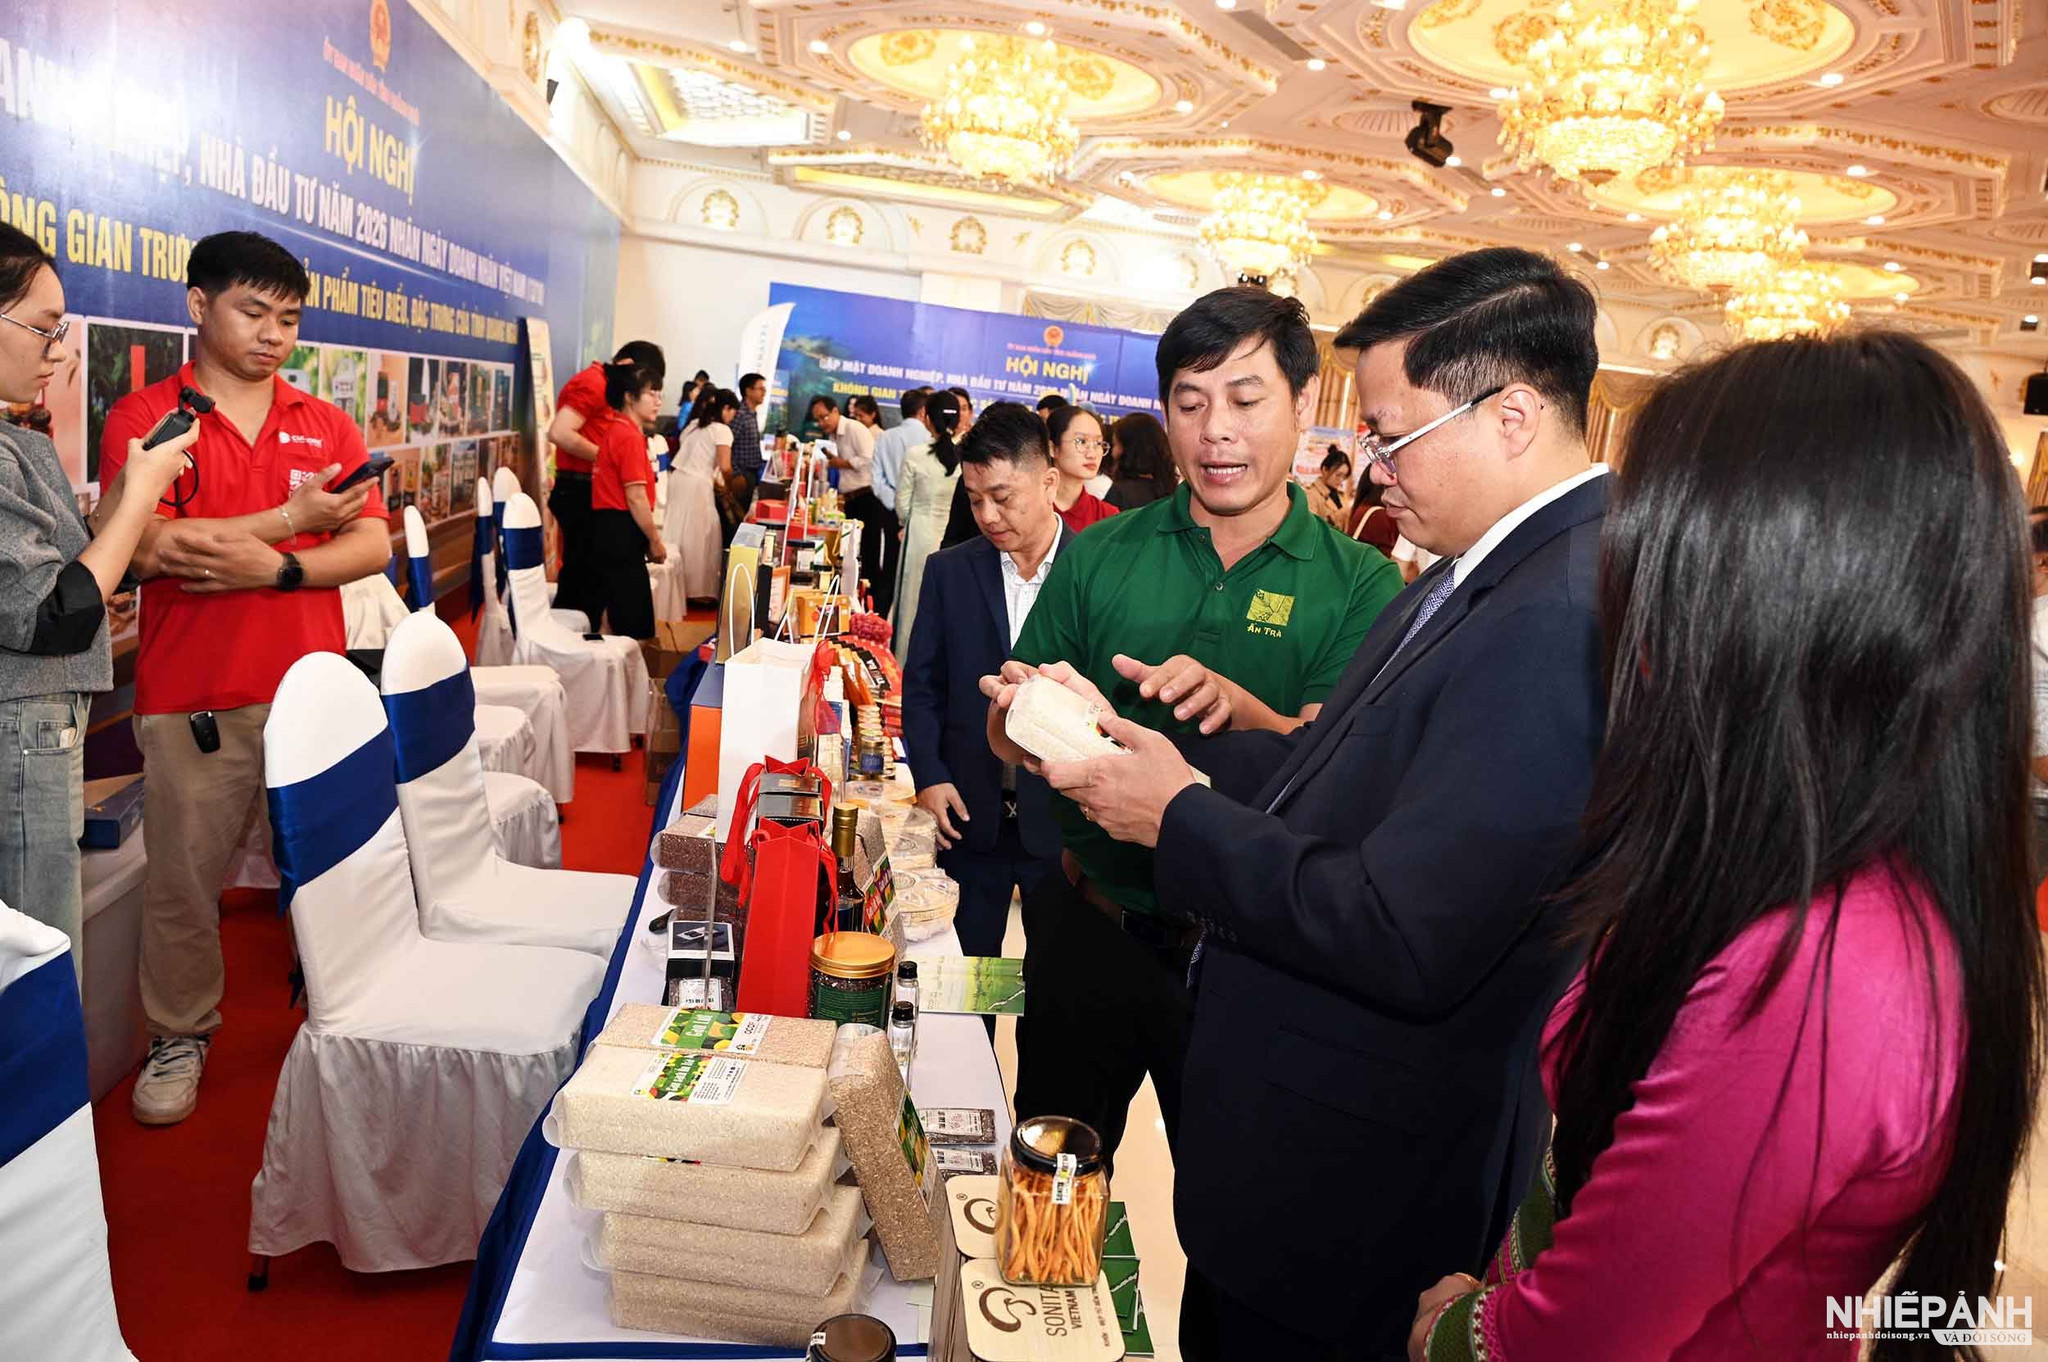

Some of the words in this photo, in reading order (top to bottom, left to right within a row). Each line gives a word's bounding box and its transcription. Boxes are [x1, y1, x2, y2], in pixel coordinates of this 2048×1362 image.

[200, 131, 246, 199] NHÀ
[295, 173, 318, 224] TƯ
[318, 180, 354, 238] NĂM
[355, 202, 387, 250] 2026
[325, 94, 365, 175] HỘI
[369, 123, 416, 206] NGHỊ
[66, 208, 132, 274] GIAN
[139, 226, 197, 284] TRƯ
[303, 257, 320, 309] ẢN
[323, 266, 359, 315] PHẨM
[361, 280, 384, 320] TIÊU
[1006, 354, 1038, 377] HỘI
[1042, 362, 1089, 385] NGHỊ
[1065, 1290, 1082, 1329] VIETNAM
